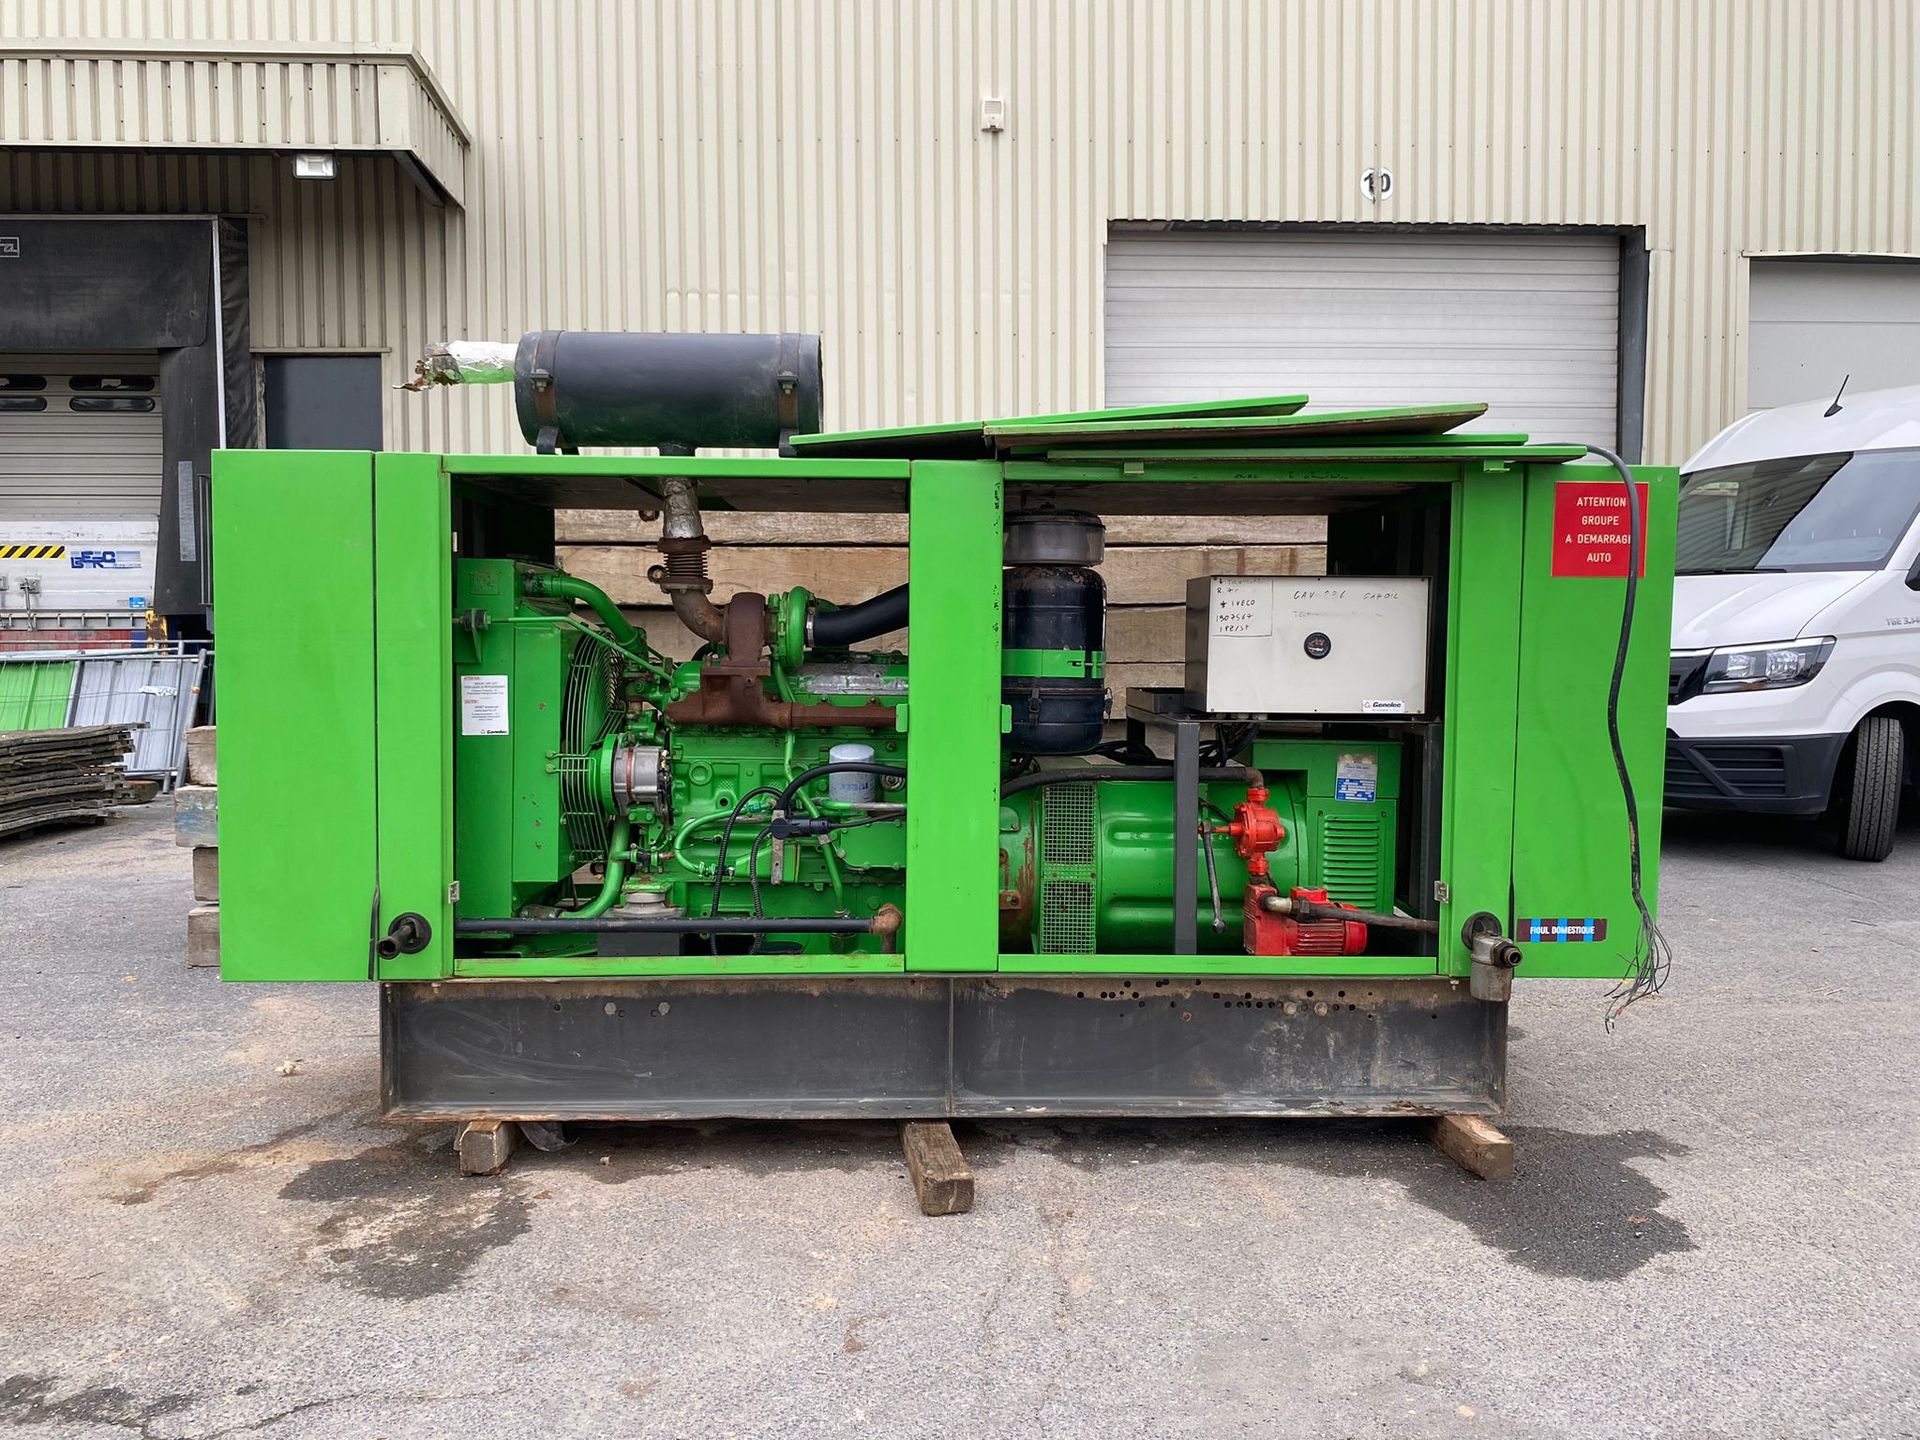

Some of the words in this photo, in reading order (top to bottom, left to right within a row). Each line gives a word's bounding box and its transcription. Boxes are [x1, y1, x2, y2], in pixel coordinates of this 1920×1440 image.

[1576, 497, 1626, 507] ATTENTION
[1581, 515, 1619, 526] GROUPE
[1565, 534, 1572, 544] A
[1586, 552, 1612, 563] AUTO
[1530, 926, 1550, 934] FIOUL
[1551, 926, 1595, 934] DOMESTIQUE
